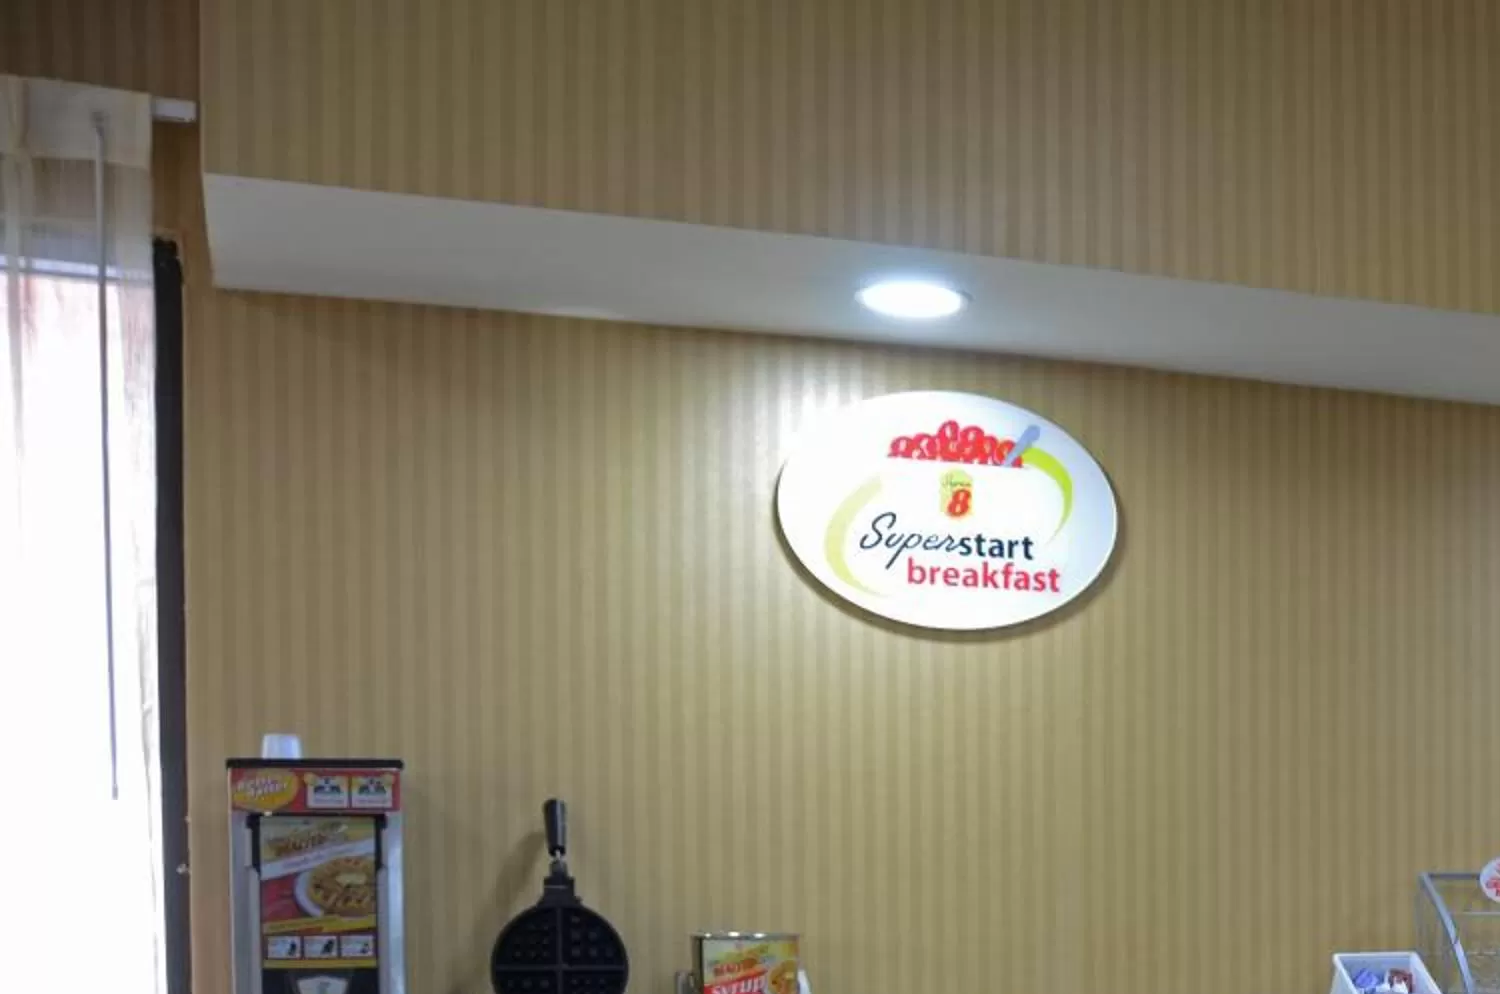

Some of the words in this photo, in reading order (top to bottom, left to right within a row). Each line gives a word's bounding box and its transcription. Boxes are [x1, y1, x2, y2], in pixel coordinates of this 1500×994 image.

[947, 488, 972, 517] 8
[859, 511, 1034, 570] Superstart
[907, 556, 1061, 593] breakfast
